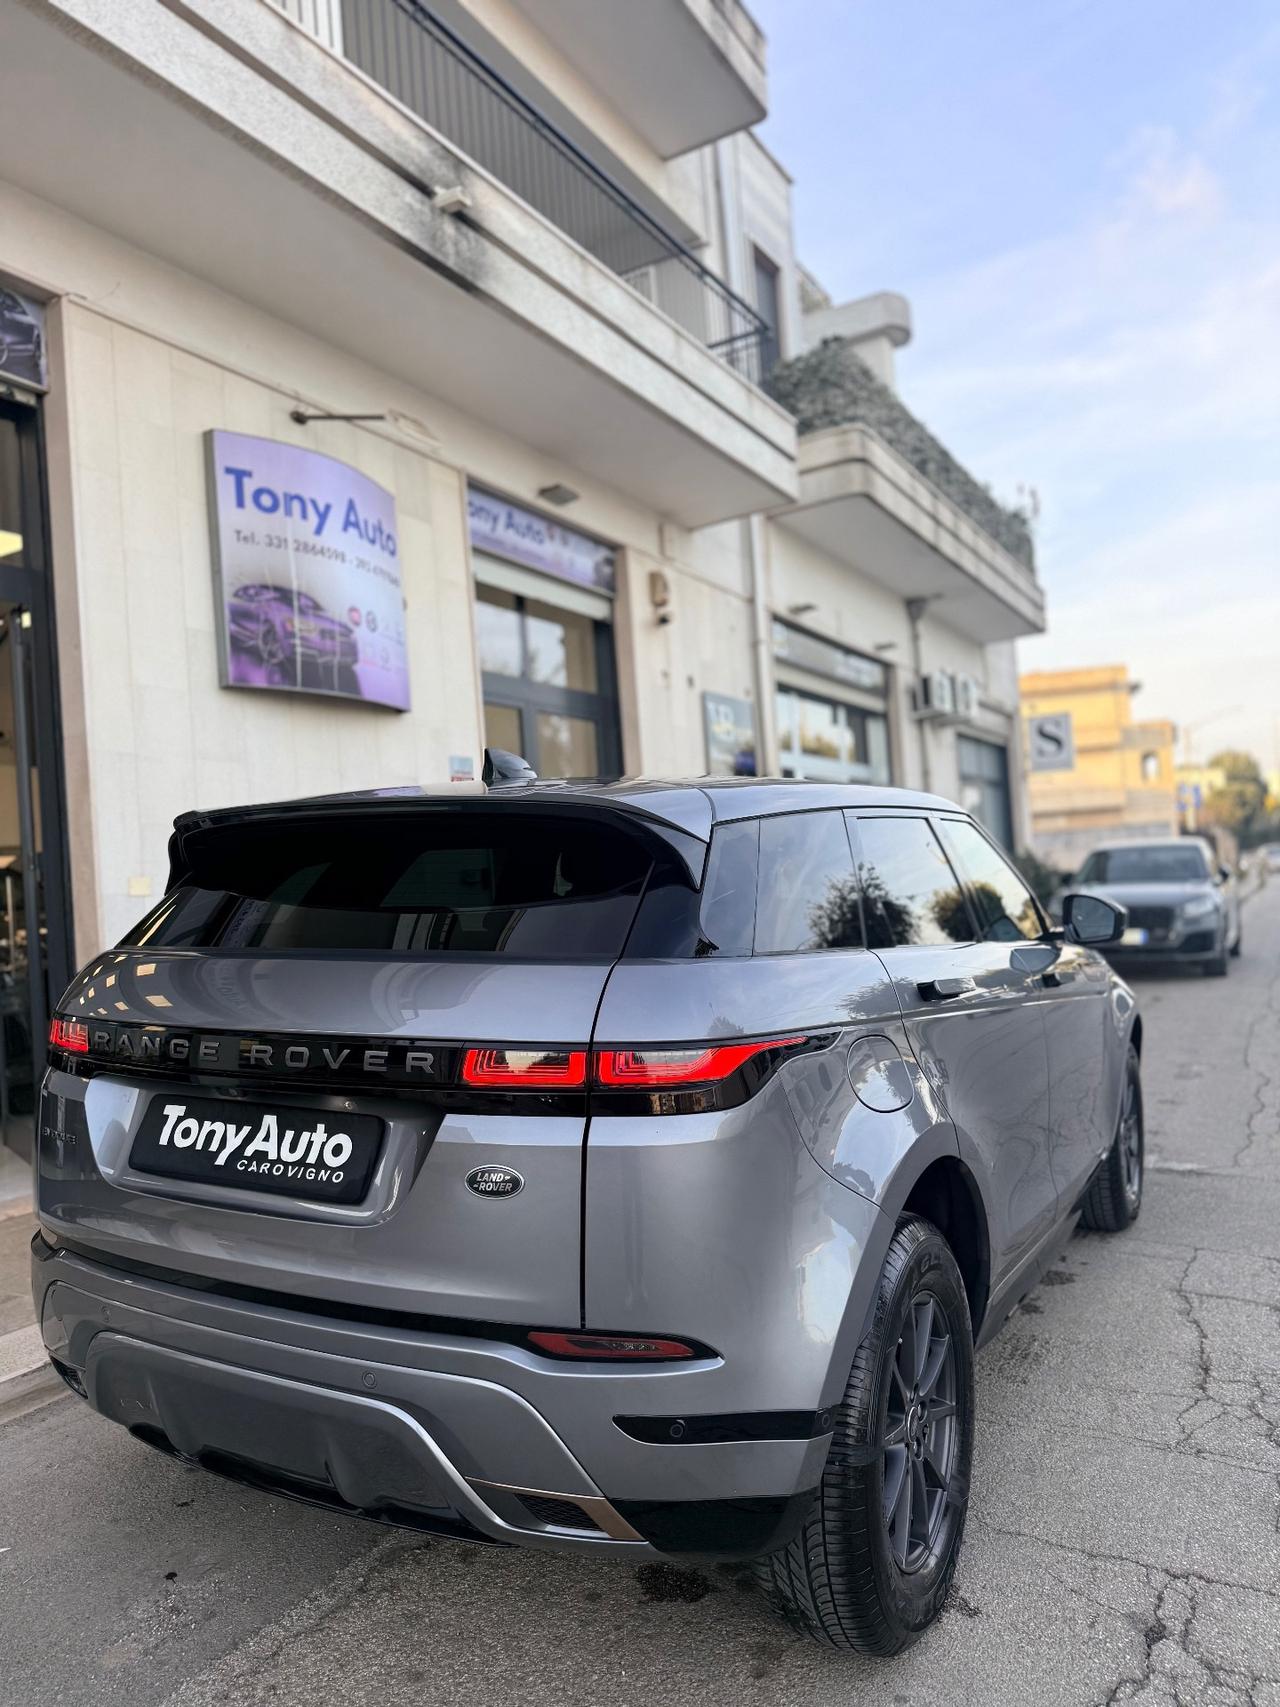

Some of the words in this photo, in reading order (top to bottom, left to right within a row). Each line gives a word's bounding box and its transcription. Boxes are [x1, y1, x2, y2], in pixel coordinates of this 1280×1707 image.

[224, 466, 332, 536] Tony
[342, 497, 397, 558] Auto
[468, 500, 499, 534] ony
[505, 509, 546, 546] Auto
[234, 529, 261, 546] Tel.
[1036, 719, 1064, 760] S
[93, 1031, 220, 1062] RANGE
[250, 1044, 435, 1074] ROVER
[158, 1104, 252, 1167] Tony
[244, 1114, 353, 1169] Auto
[236, 1159, 345, 1184] CAROVIGNO
[476, 1172, 504, 1182] LAND
[479, 1182, 513, 1192] ROVER
